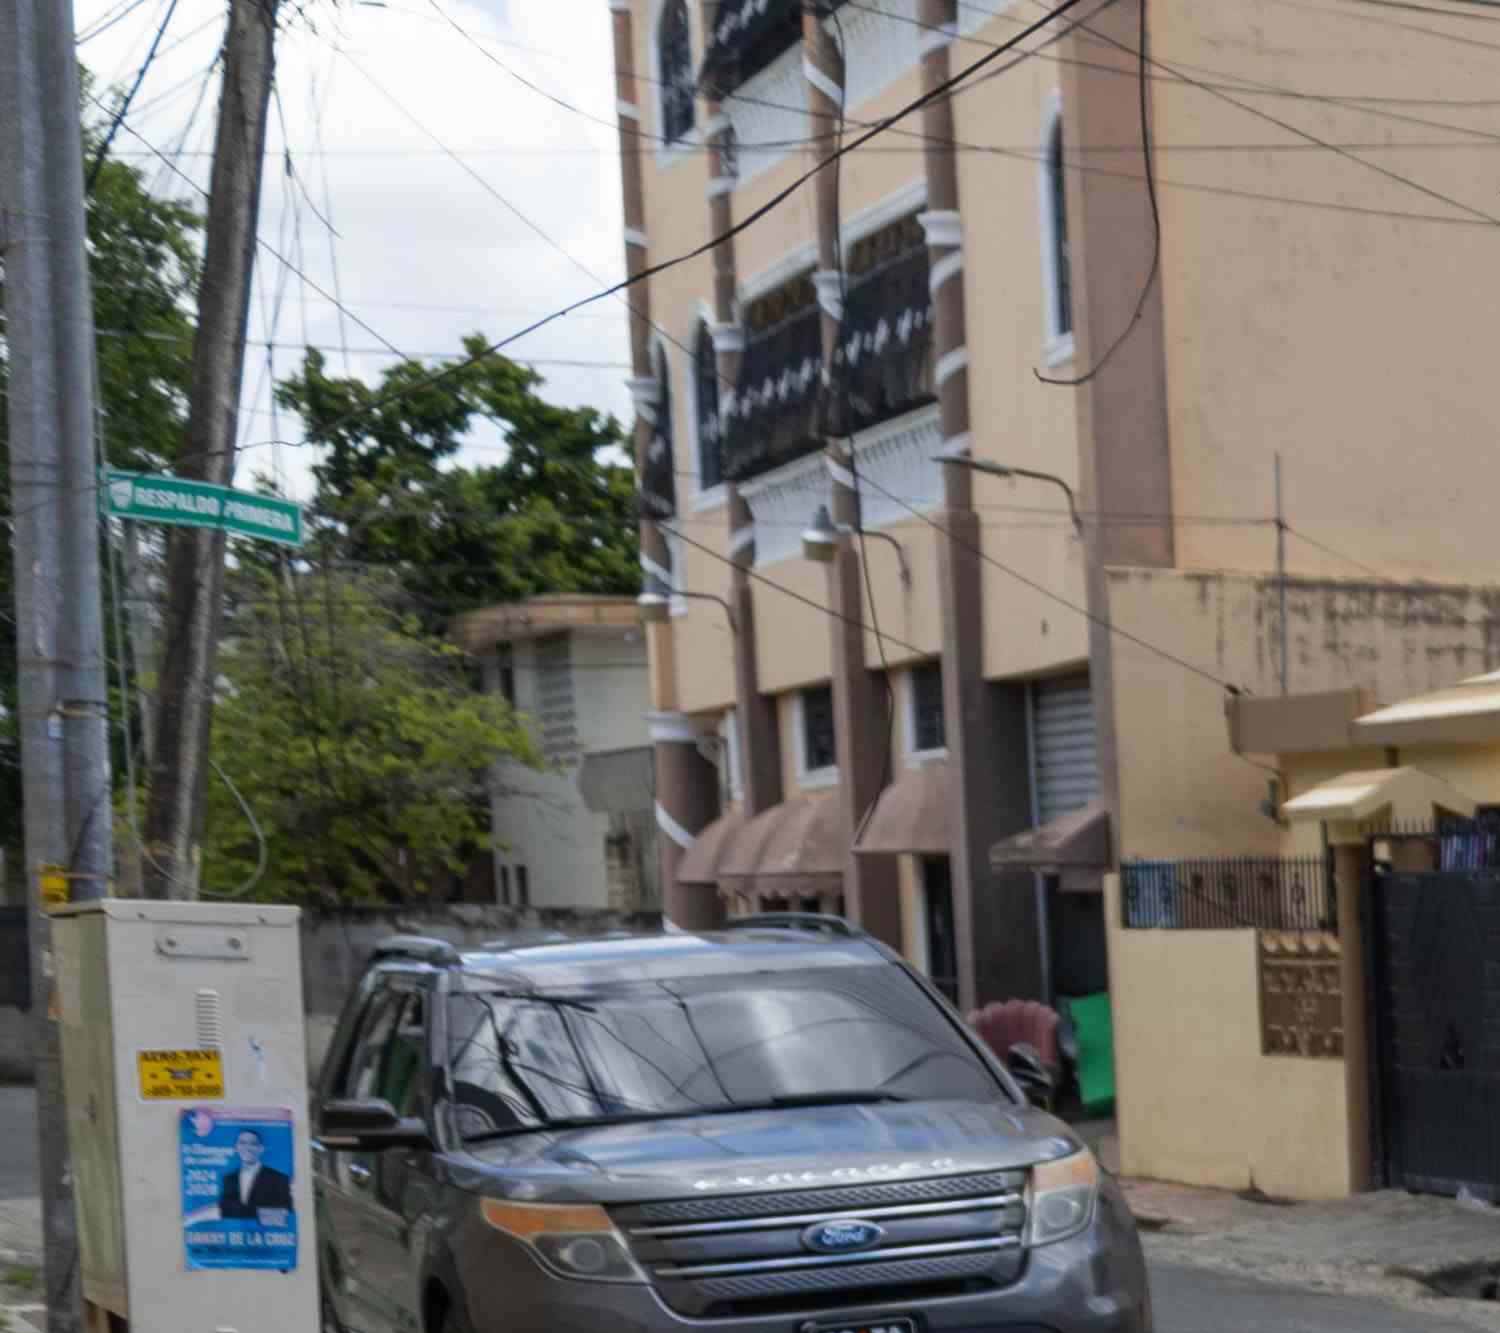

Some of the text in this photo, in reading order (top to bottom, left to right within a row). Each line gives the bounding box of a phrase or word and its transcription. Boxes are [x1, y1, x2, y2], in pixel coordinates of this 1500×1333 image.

[135, 487, 295, 531] RESPALDO PRIMERA
[229, 1232, 243, 1245] DE
[247, 1232, 262, 1245] LA
[265, 1232, 295, 1245] CRUZ
[821, 1225, 867, 1245] Ford
